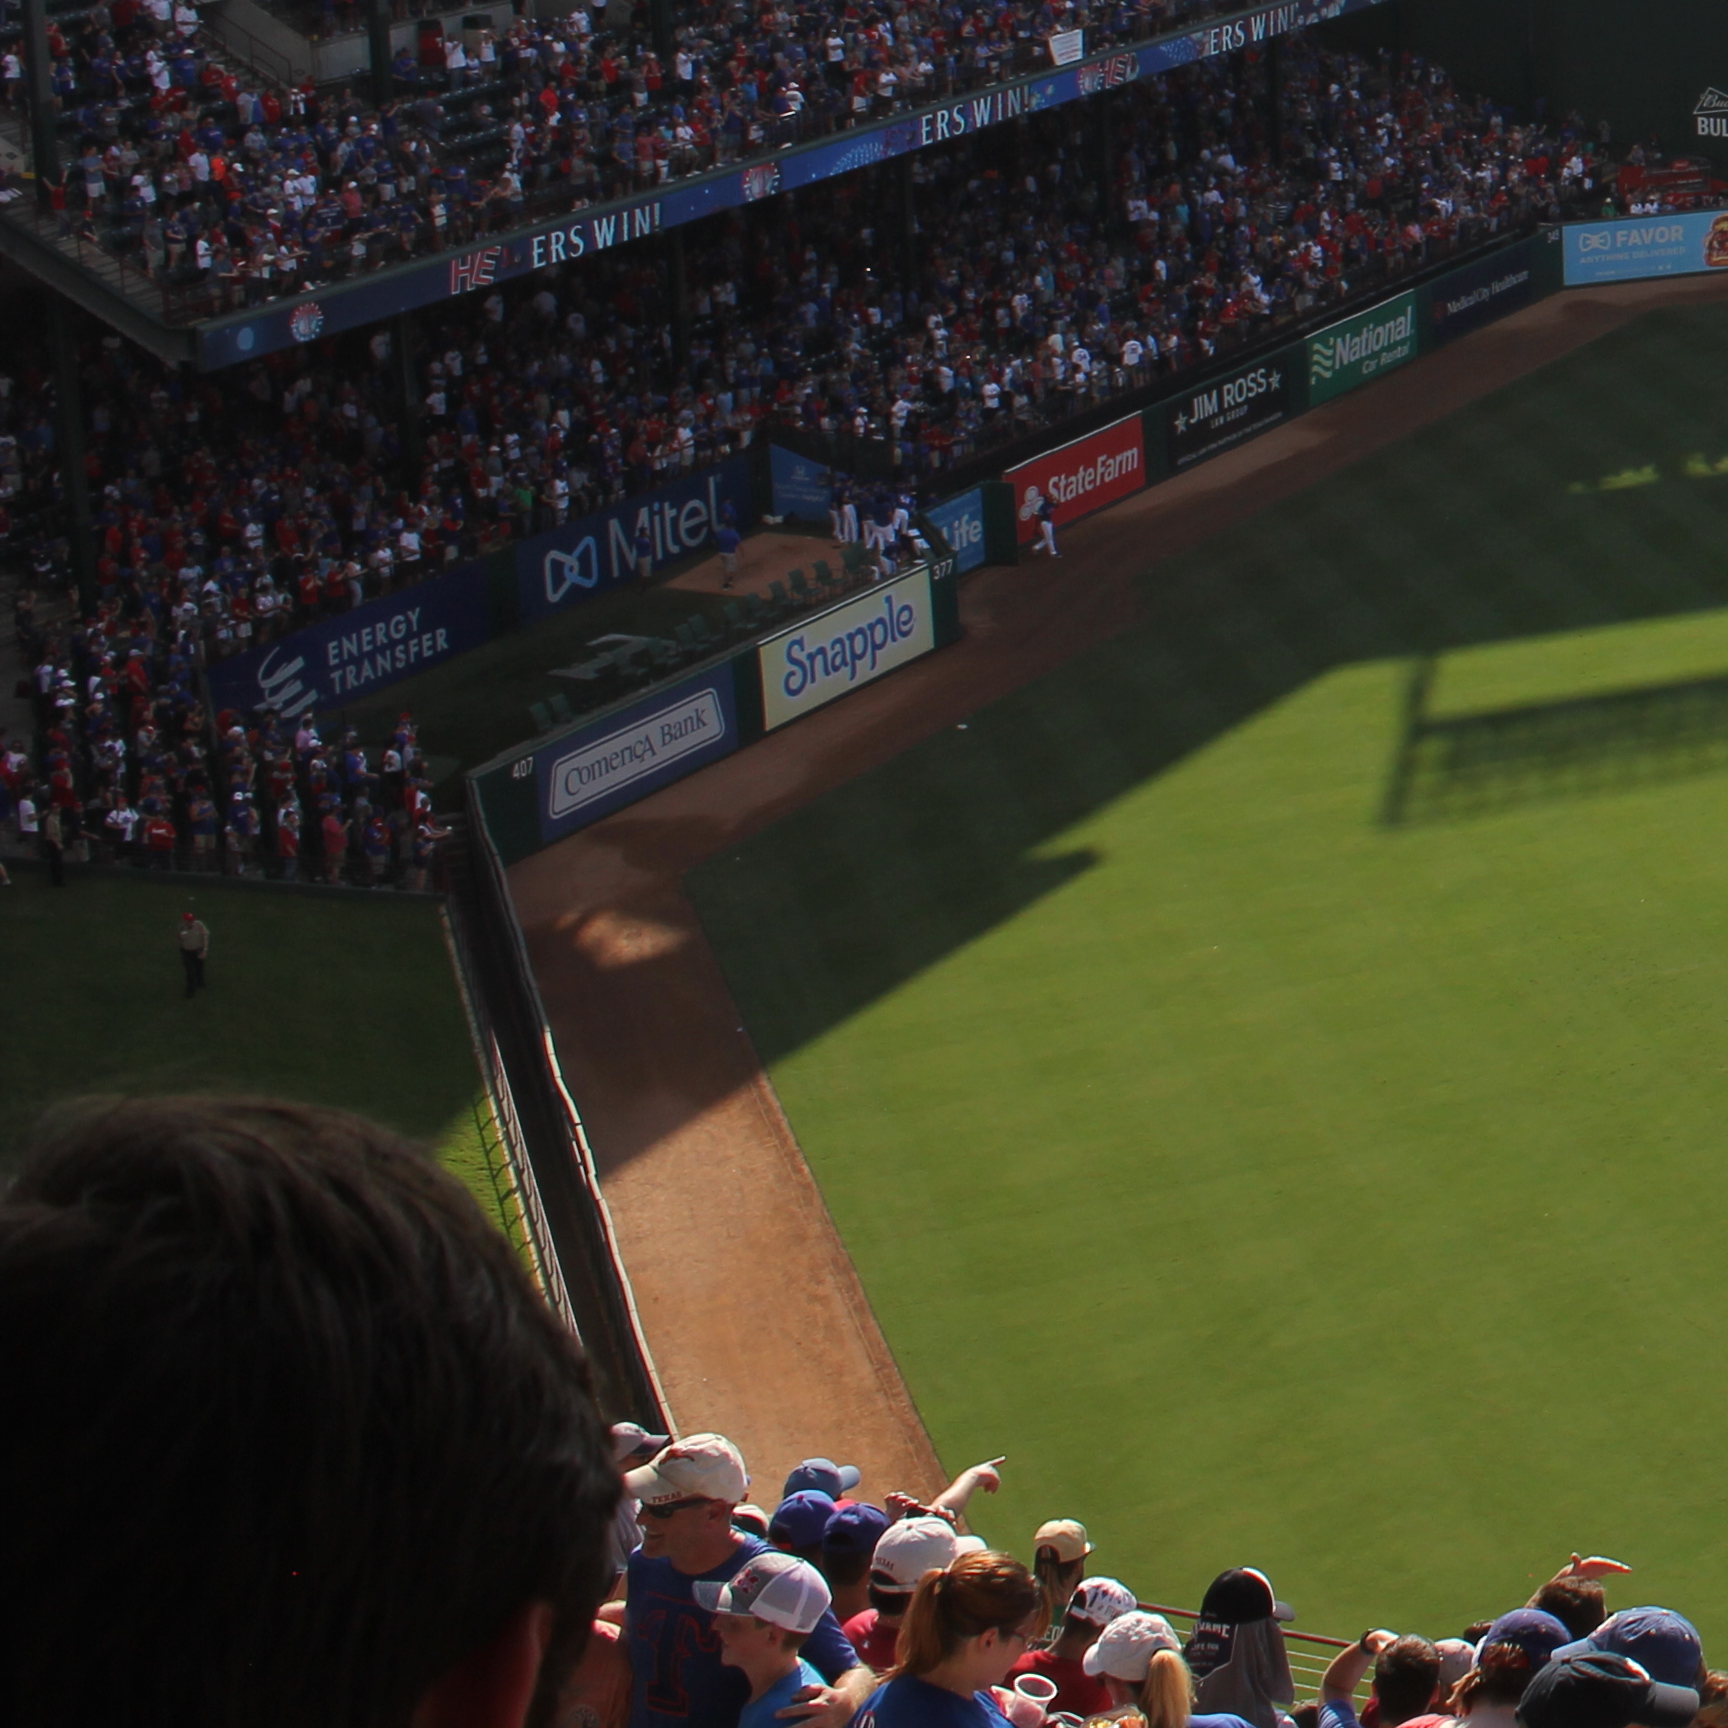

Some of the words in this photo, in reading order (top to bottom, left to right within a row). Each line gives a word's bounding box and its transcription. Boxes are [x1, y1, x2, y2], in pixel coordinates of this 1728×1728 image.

[1209, 24, 1247, 57] ERS
[1250, 2, 1298, 45] WIN!
[920, 108, 966, 146] ERS
[972, 83, 1031, 131] WIN!
[532, 224, 586, 269] ERS
[593, 202, 662, 250] WIN!
[1616, 225, 1684, 248] FAVOR
[1334, 305, 1413, 370] National
[1361, 358, 1378, 375] Car
[1379, 342, 1410, 367] Rental
[1189, 389, 1219, 424] JIM
[1222, 368, 1267, 408] ROSS
[608, 473, 723, 578] Mitel
[932, 559, 954, 580] 377
[326, 607, 421, 667] ENERGY
[330, 627, 450, 695] TRANSFER
[784, 595, 914, 697] Snapple
[660, 707, 708, 750] Bank
[512, 756, 534, 780] 407
[652, 1491, 683, 1503] TEXAS
